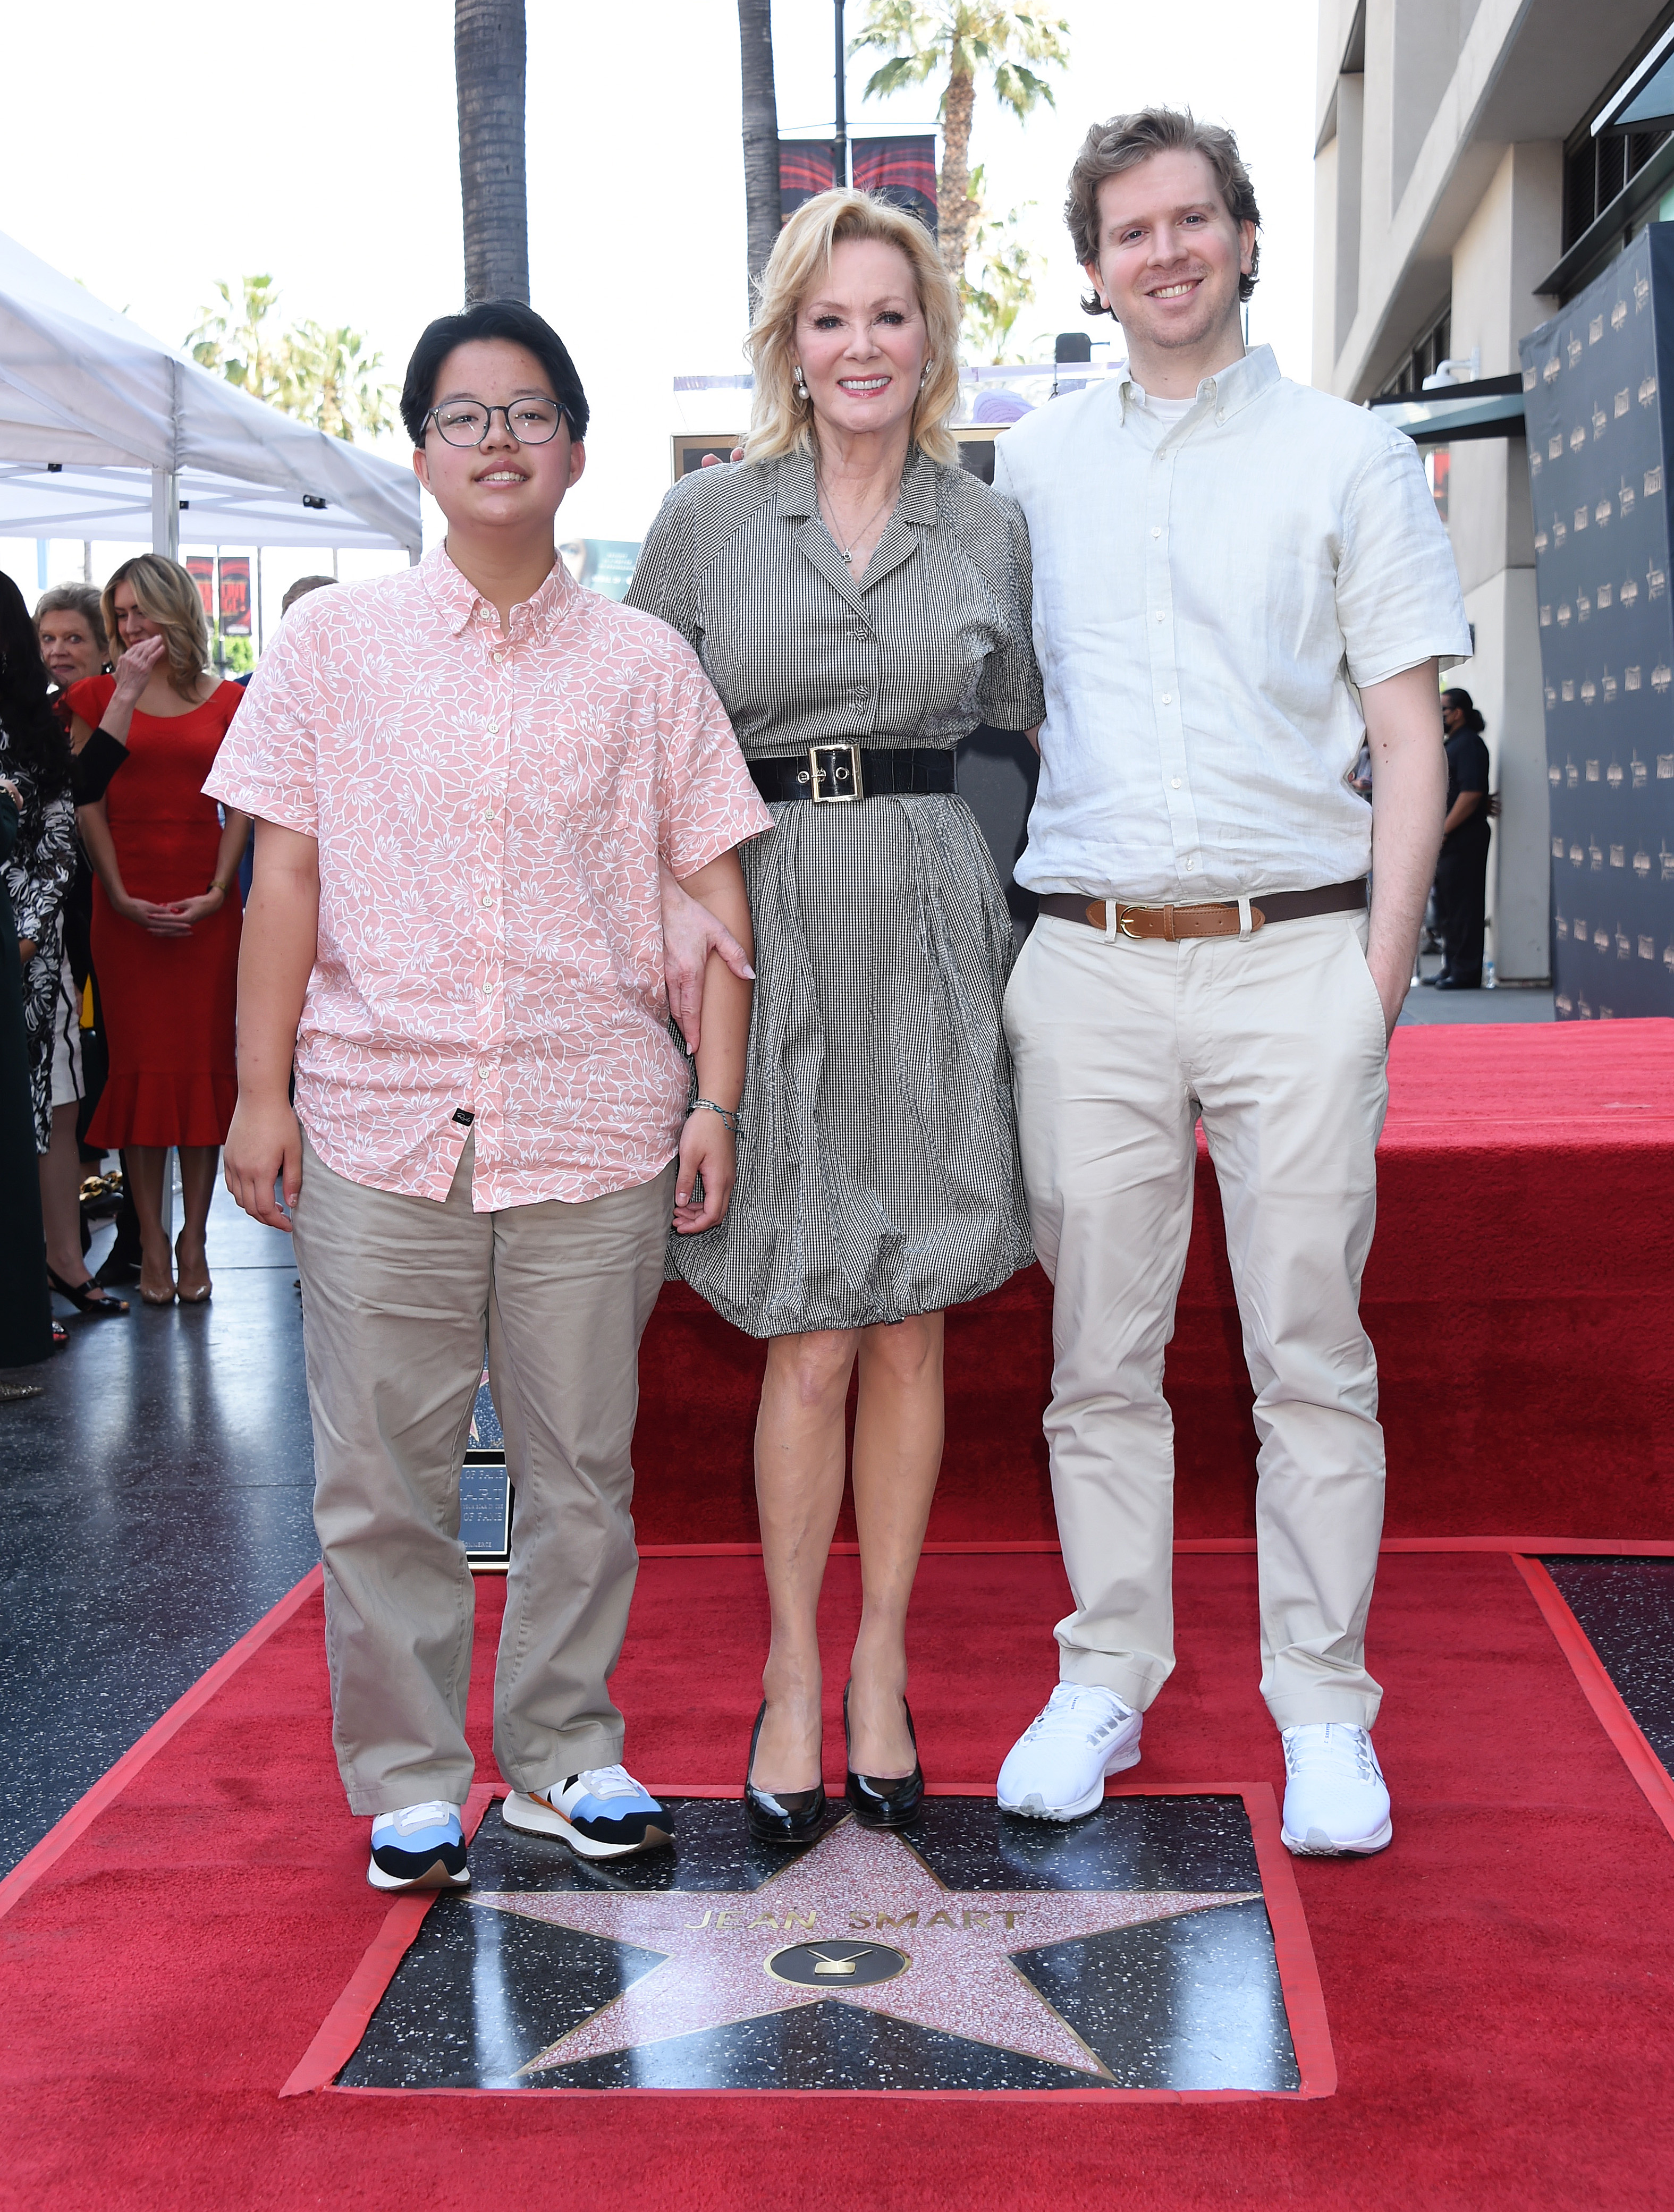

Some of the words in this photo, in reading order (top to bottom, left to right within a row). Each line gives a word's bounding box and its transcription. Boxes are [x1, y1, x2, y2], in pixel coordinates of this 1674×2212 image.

[466, 1470, 476, 1479] OF
[460, 1489, 503, 1500] ART
[463, 1512, 474, 1521] OF
[477, 1512, 502, 1521] FAME
[683, 1910, 817, 1929] JEAN
[848, 1910, 1027, 1930] SMART
